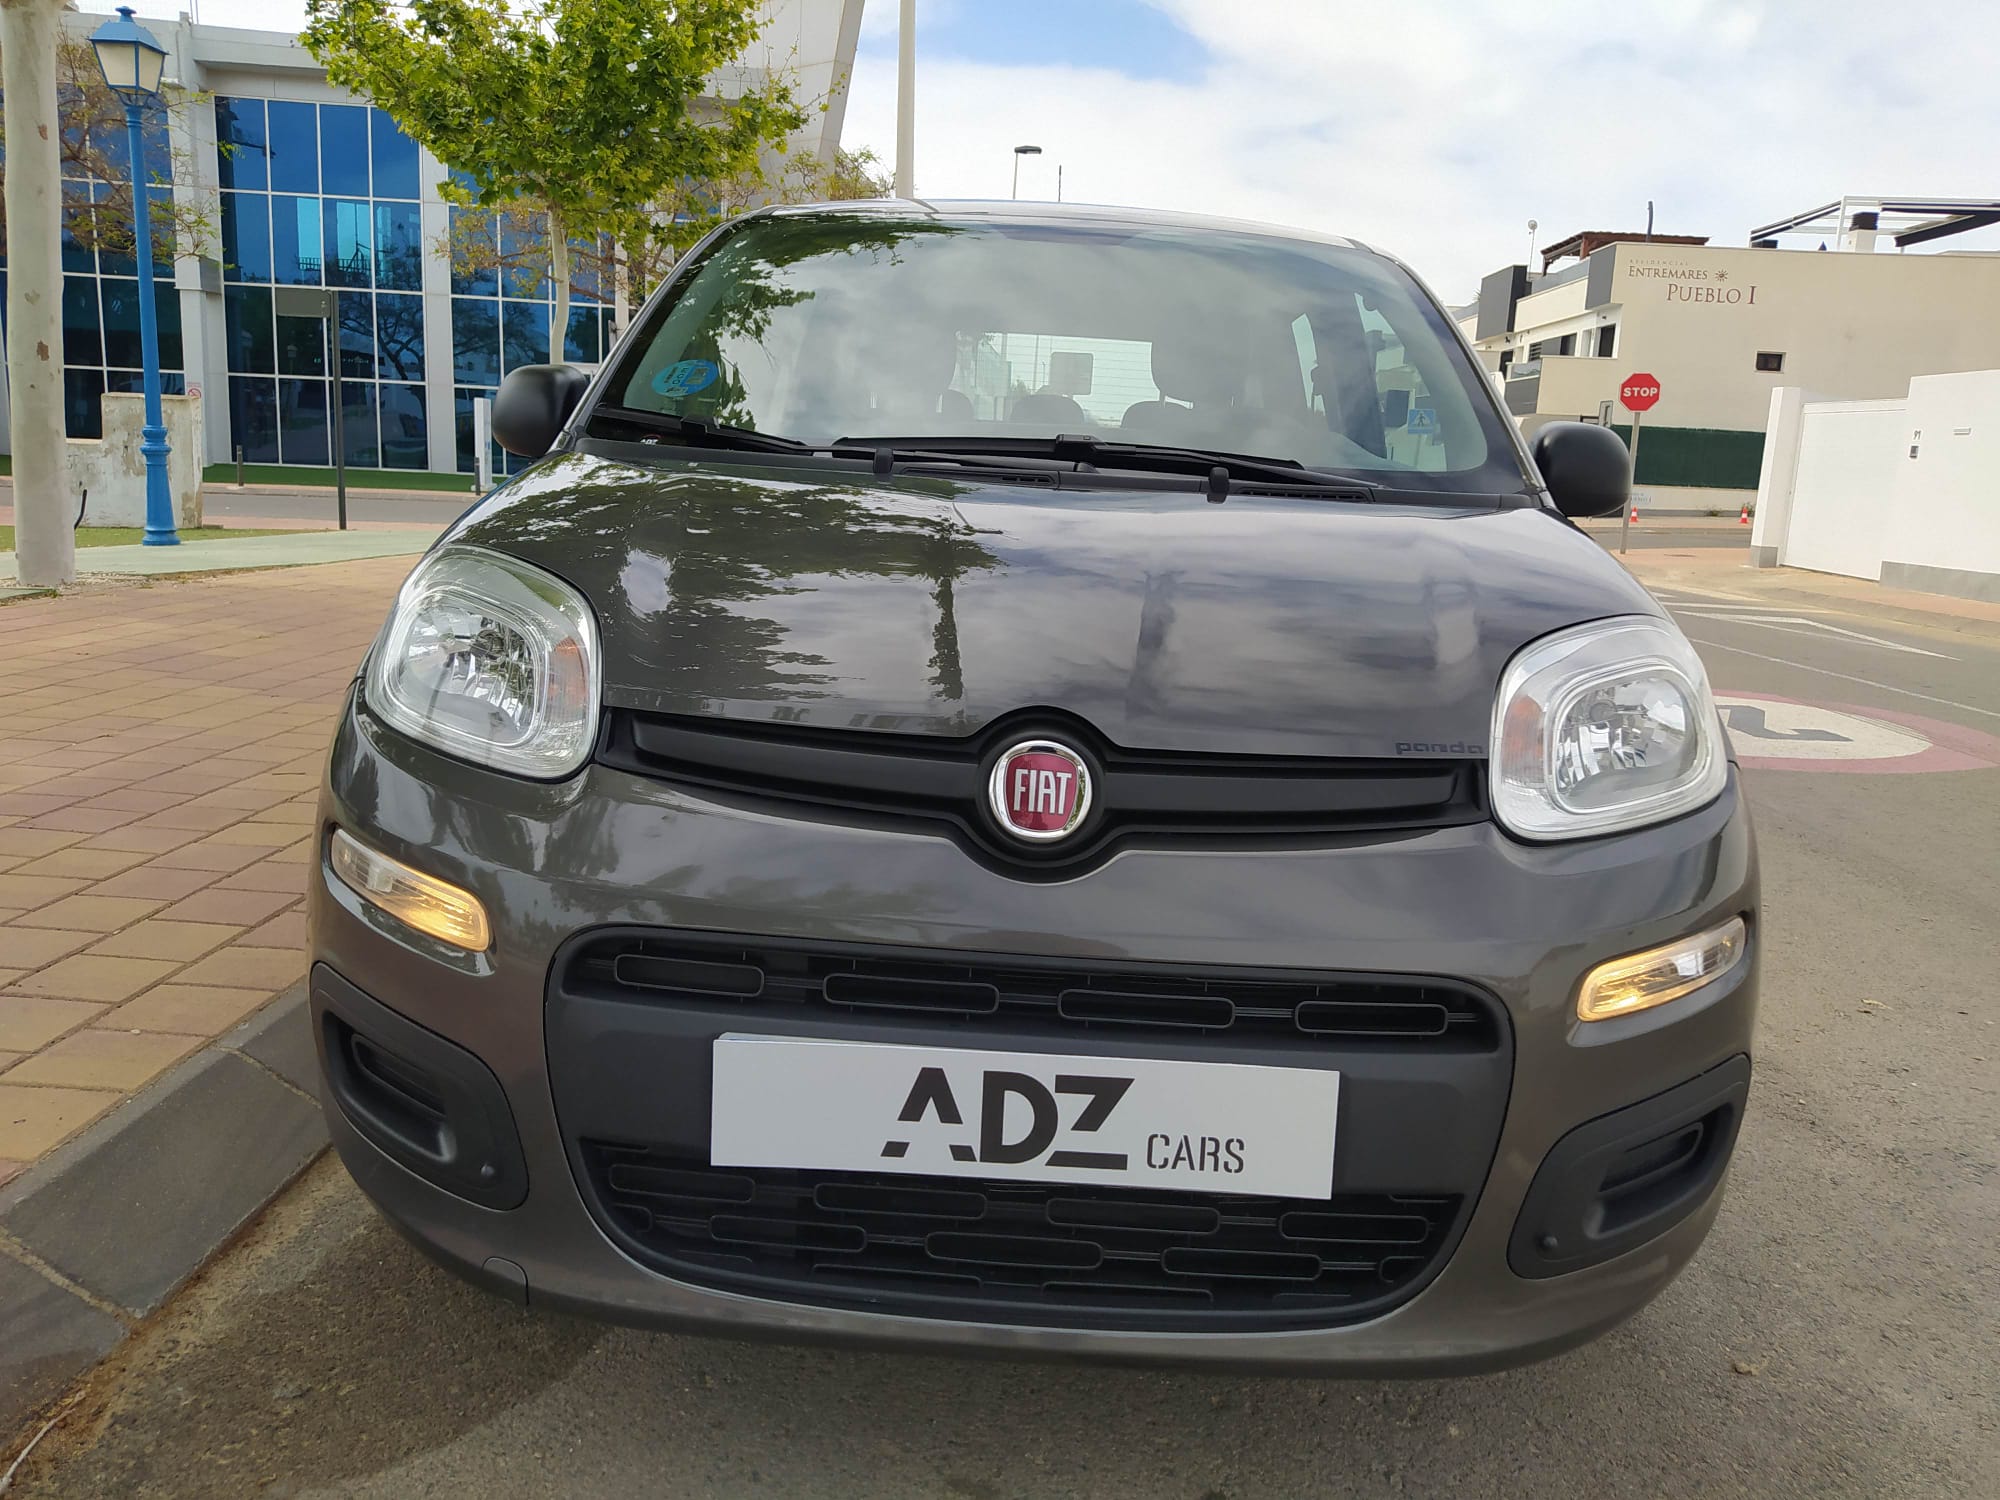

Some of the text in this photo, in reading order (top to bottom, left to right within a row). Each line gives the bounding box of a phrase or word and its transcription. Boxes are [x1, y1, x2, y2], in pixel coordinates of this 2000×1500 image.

[1628, 265, 1708, 280] ENTREMARES
[1666, 283, 1757, 305] PUEBLO I
[1623, 387, 1658, 397] STOP
[1395, 741, 1484, 755] panda
[1013, 768, 1072, 815] FIAT
[880, 1066, 1245, 1174] ADZ CARS
